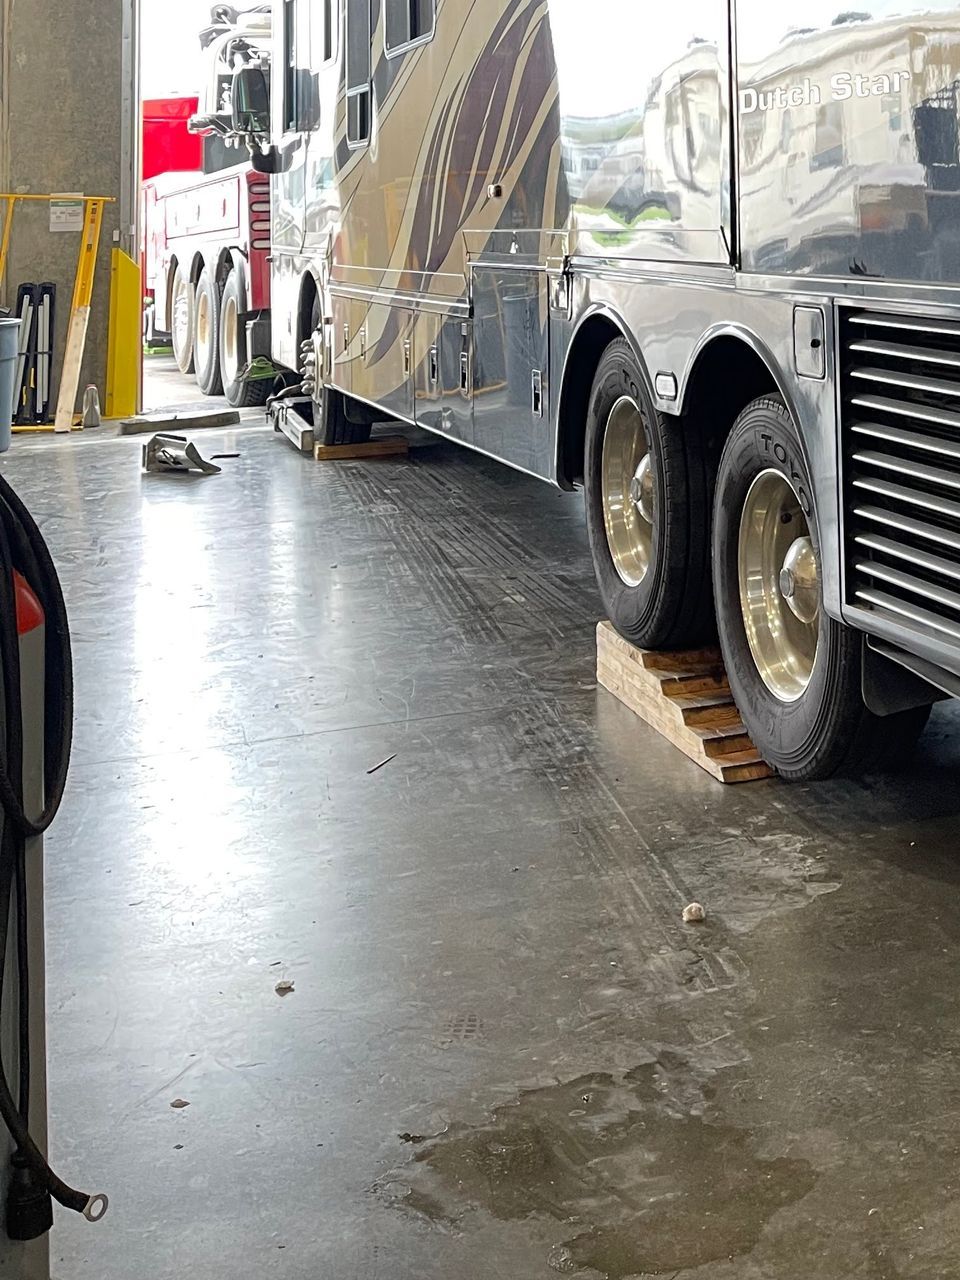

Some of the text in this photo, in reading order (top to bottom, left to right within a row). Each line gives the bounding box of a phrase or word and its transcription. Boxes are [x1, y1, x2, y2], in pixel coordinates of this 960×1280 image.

[740, 70, 910, 114] Dutch Star
[761, 433, 811, 518] TOYO
